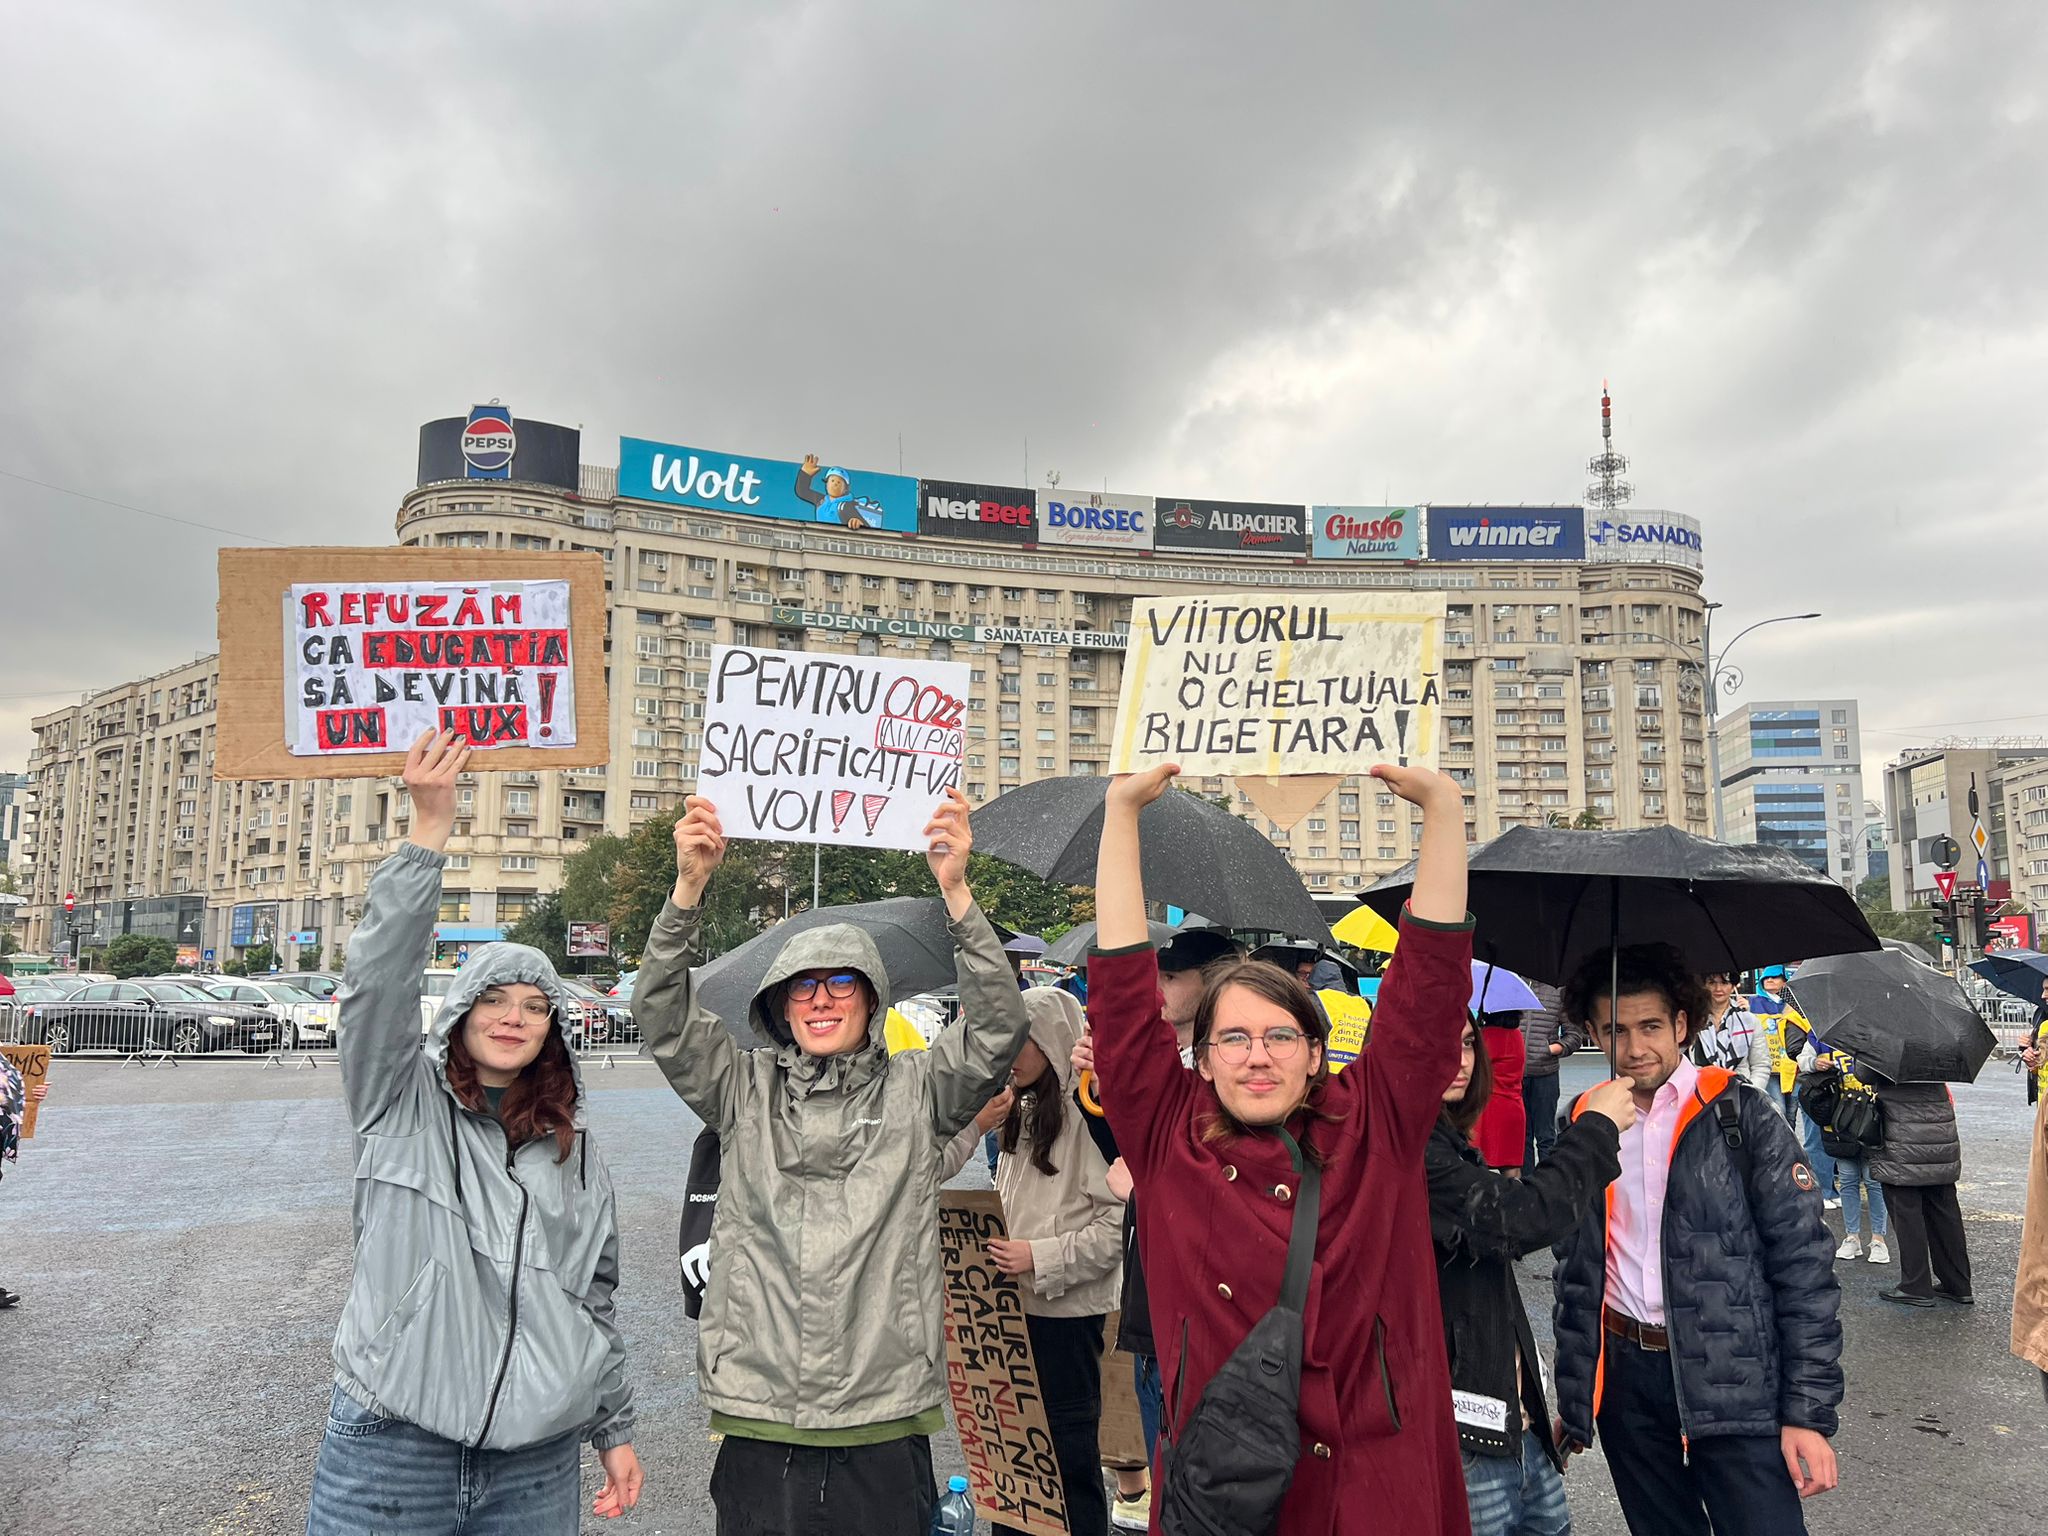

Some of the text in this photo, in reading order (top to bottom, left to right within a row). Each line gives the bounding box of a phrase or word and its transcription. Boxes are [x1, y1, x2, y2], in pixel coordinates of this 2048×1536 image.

[464, 437, 512, 449] PEPSI
[652, 454, 762, 505] Wolt
[928, 496, 1031, 526] NetBet
[1048, 502, 1144, 532] BORSEC
[1208, 510, 1300, 535] ALBACHER
[1325, 514, 1403, 540] Giusto
[1449, 518, 1561, 546] winner
[1617, 524, 1702, 552] SANADOR
[1346, 540, 1398, 555] Natura
[301, 588, 523, 629] REFUZĂM
[801, 611, 964, 639] EDENT CLINIC
[1072, 633, 1081, 645] E
[303, 635, 354, 666] CA
[1183, 650, 1273, 674] NU E
[303, 668, 354, 707] SĂ
[716, 649, 881, 716] PENTRU
[1178, 676, 1205, 711] O
[324, 706, 523, 745] UN LUX
[949, 1208, 980, 1252] PE
[966, 1265, 1004, 1369] CARE
[989, 1379, 1021, 1432] NU
[973, 1213, 1069, 1533] SNGURUL COST
[972, 1386, 1006, 1464] ESTE
[994, 1470, 1021, 1512] SĂ
